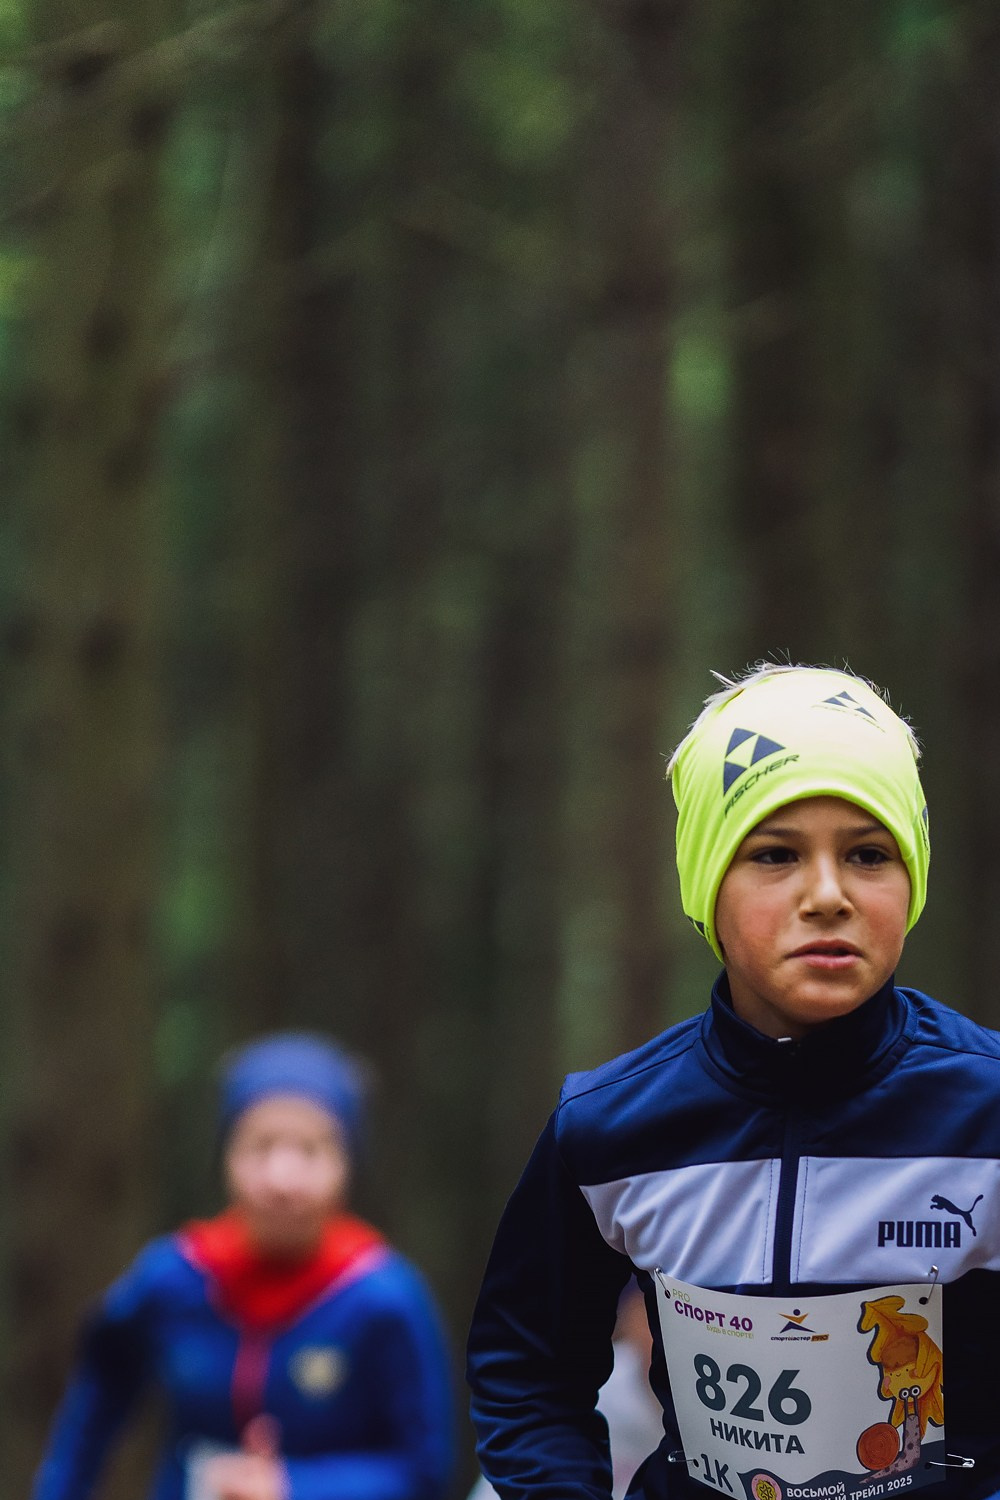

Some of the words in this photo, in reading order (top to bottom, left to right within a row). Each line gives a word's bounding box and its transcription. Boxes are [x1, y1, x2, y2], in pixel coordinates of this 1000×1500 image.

[725, 754, 800, 819] FISCHER
[877, 1220, 961, 1248] PUMA
[672, 1288, 691, 1303] PRO
[674, 1300, 725, 1327] СПОРТ
[729, 1315, 753, 1332] 40
[706, 1324, 722, 1334] БУДЬ
[693, 1353, 812, 1426] 826
[709, 1417, 805, 1455] НИКИТА
[786, 1481, 846, 1498] ВОСЬМОЙ
[887, 1475, 913, 1491] 2025
